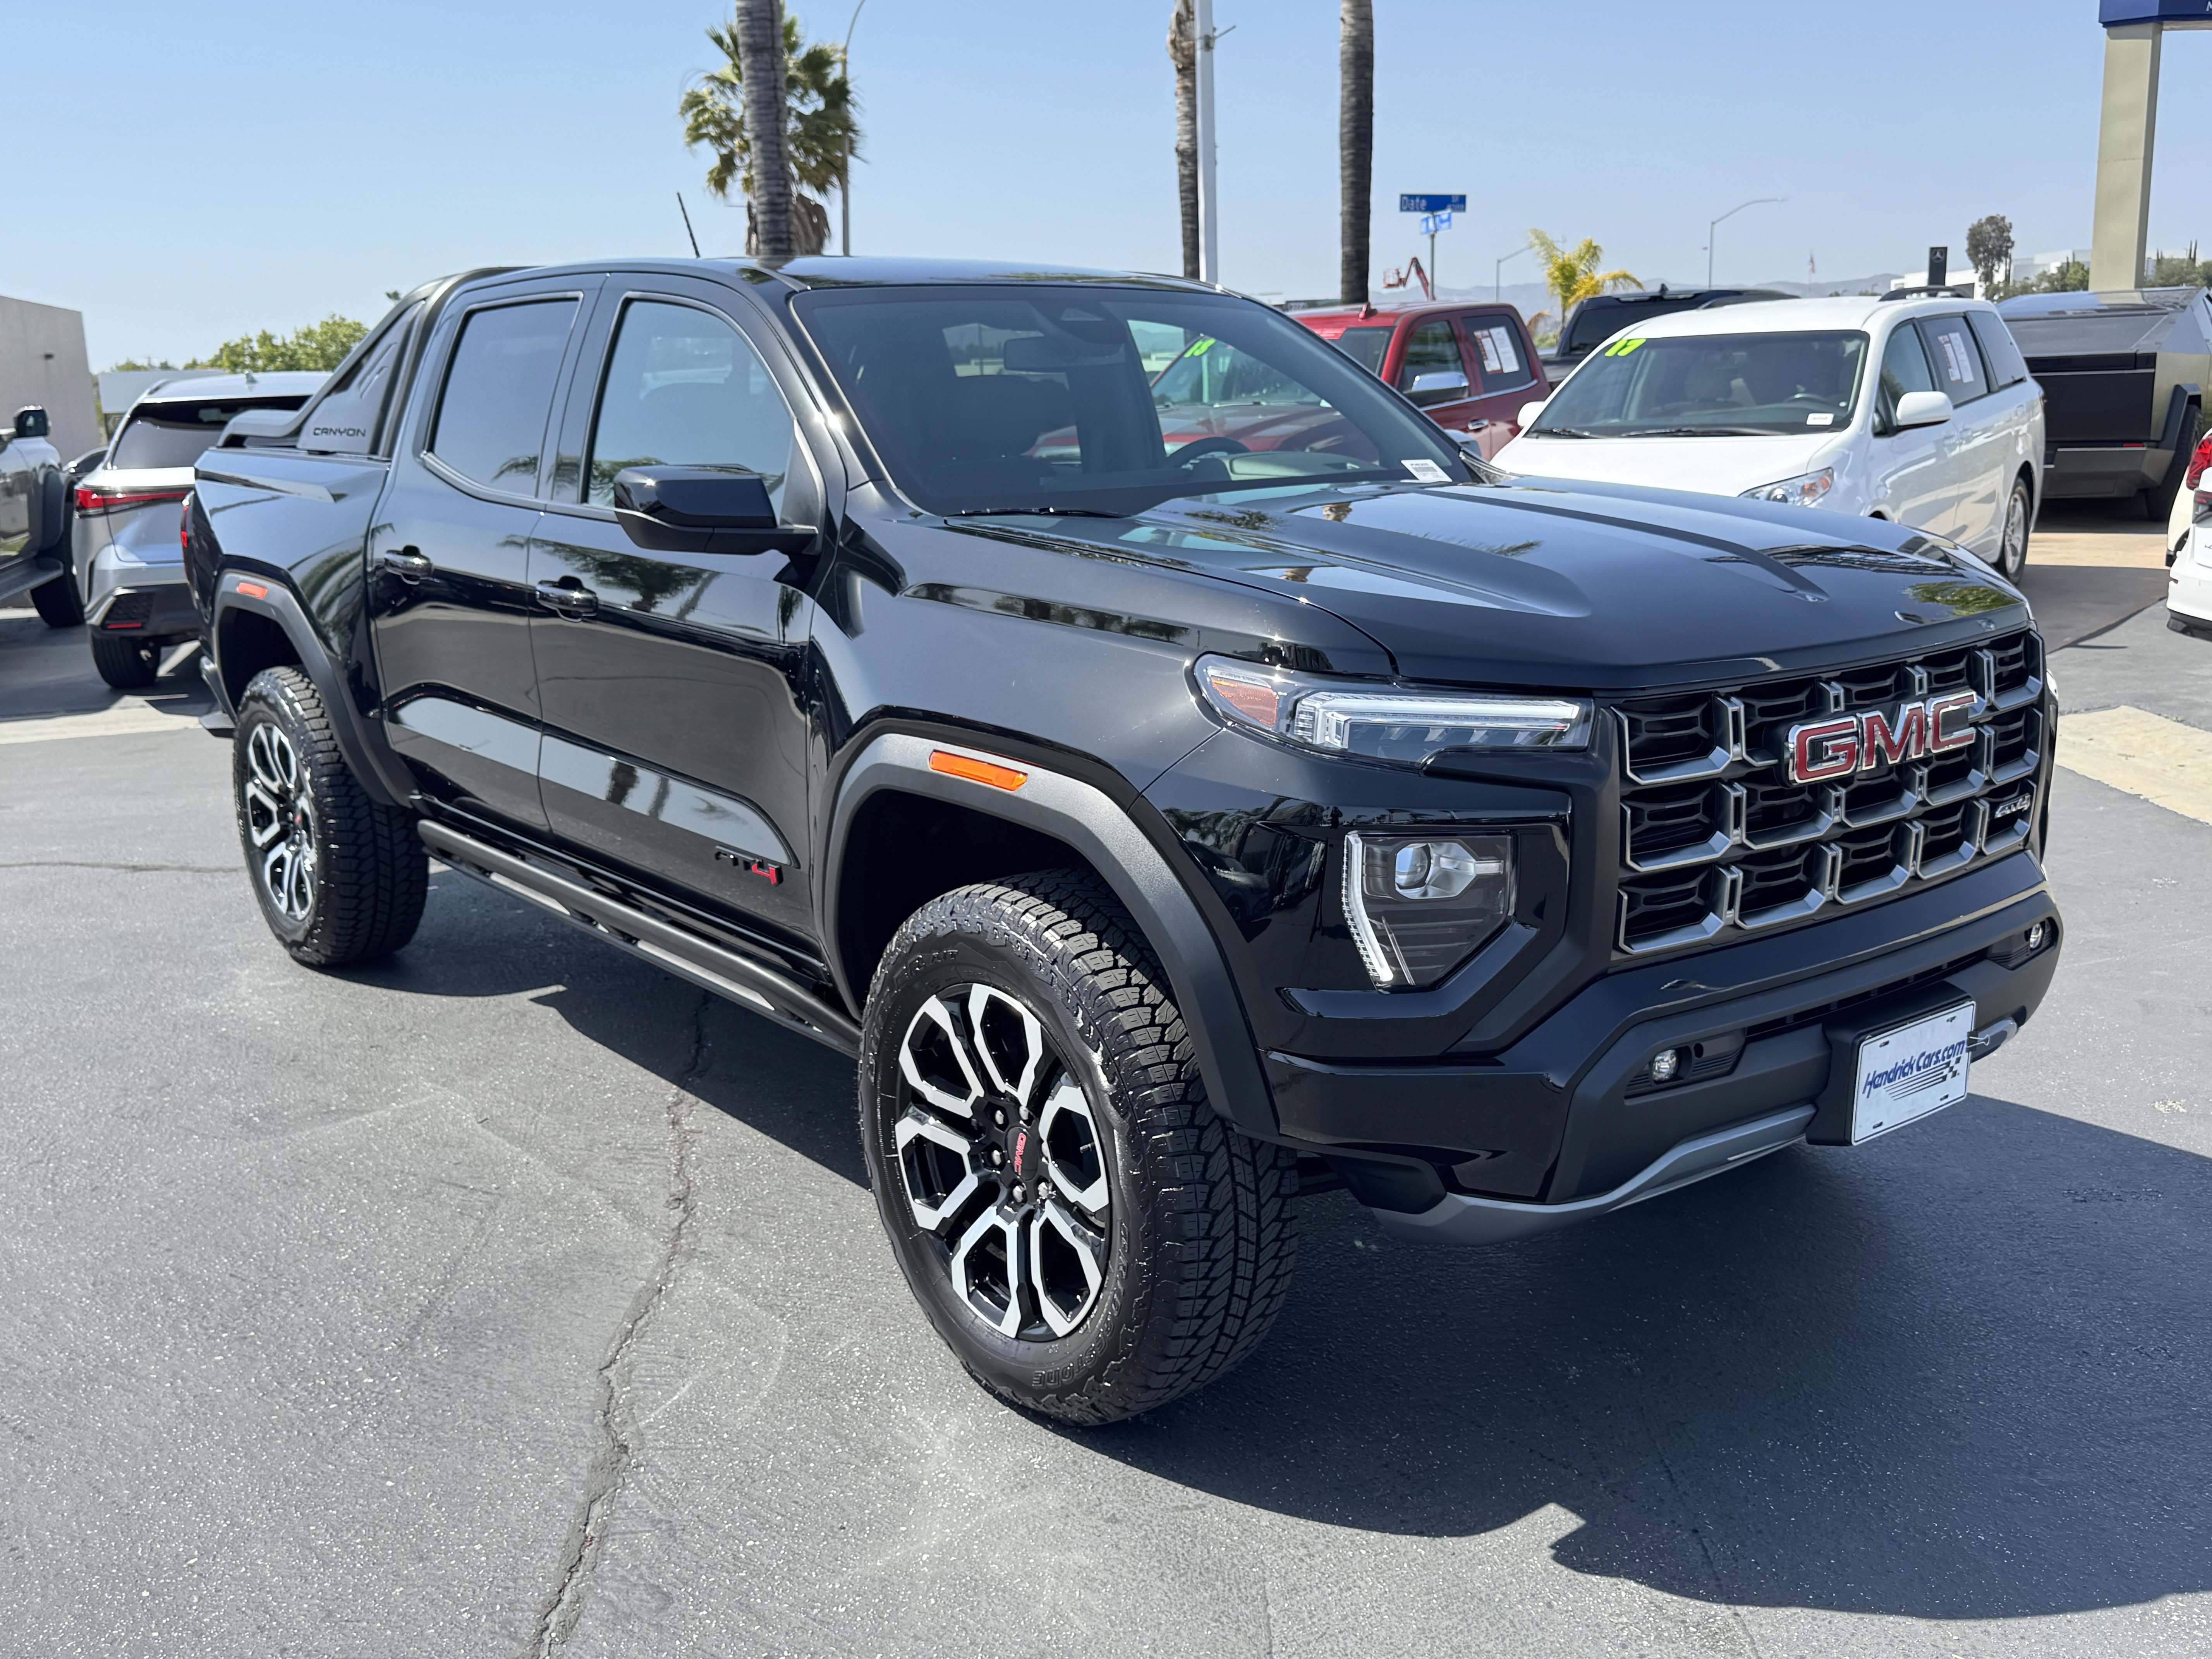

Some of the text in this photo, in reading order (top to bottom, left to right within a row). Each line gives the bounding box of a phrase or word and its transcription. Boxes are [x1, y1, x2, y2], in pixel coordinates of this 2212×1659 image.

[1401, 196, 1427, 210] Date
[1605, 338, 1647, 357] 17
[313, 427, 366, 437] CANYON
[1788, 689, 1977, 784] GMC
[1014, 1132, 1027, 1176] GMC
[1032, 1218, 1130, 1389] BRIDGESTONE
